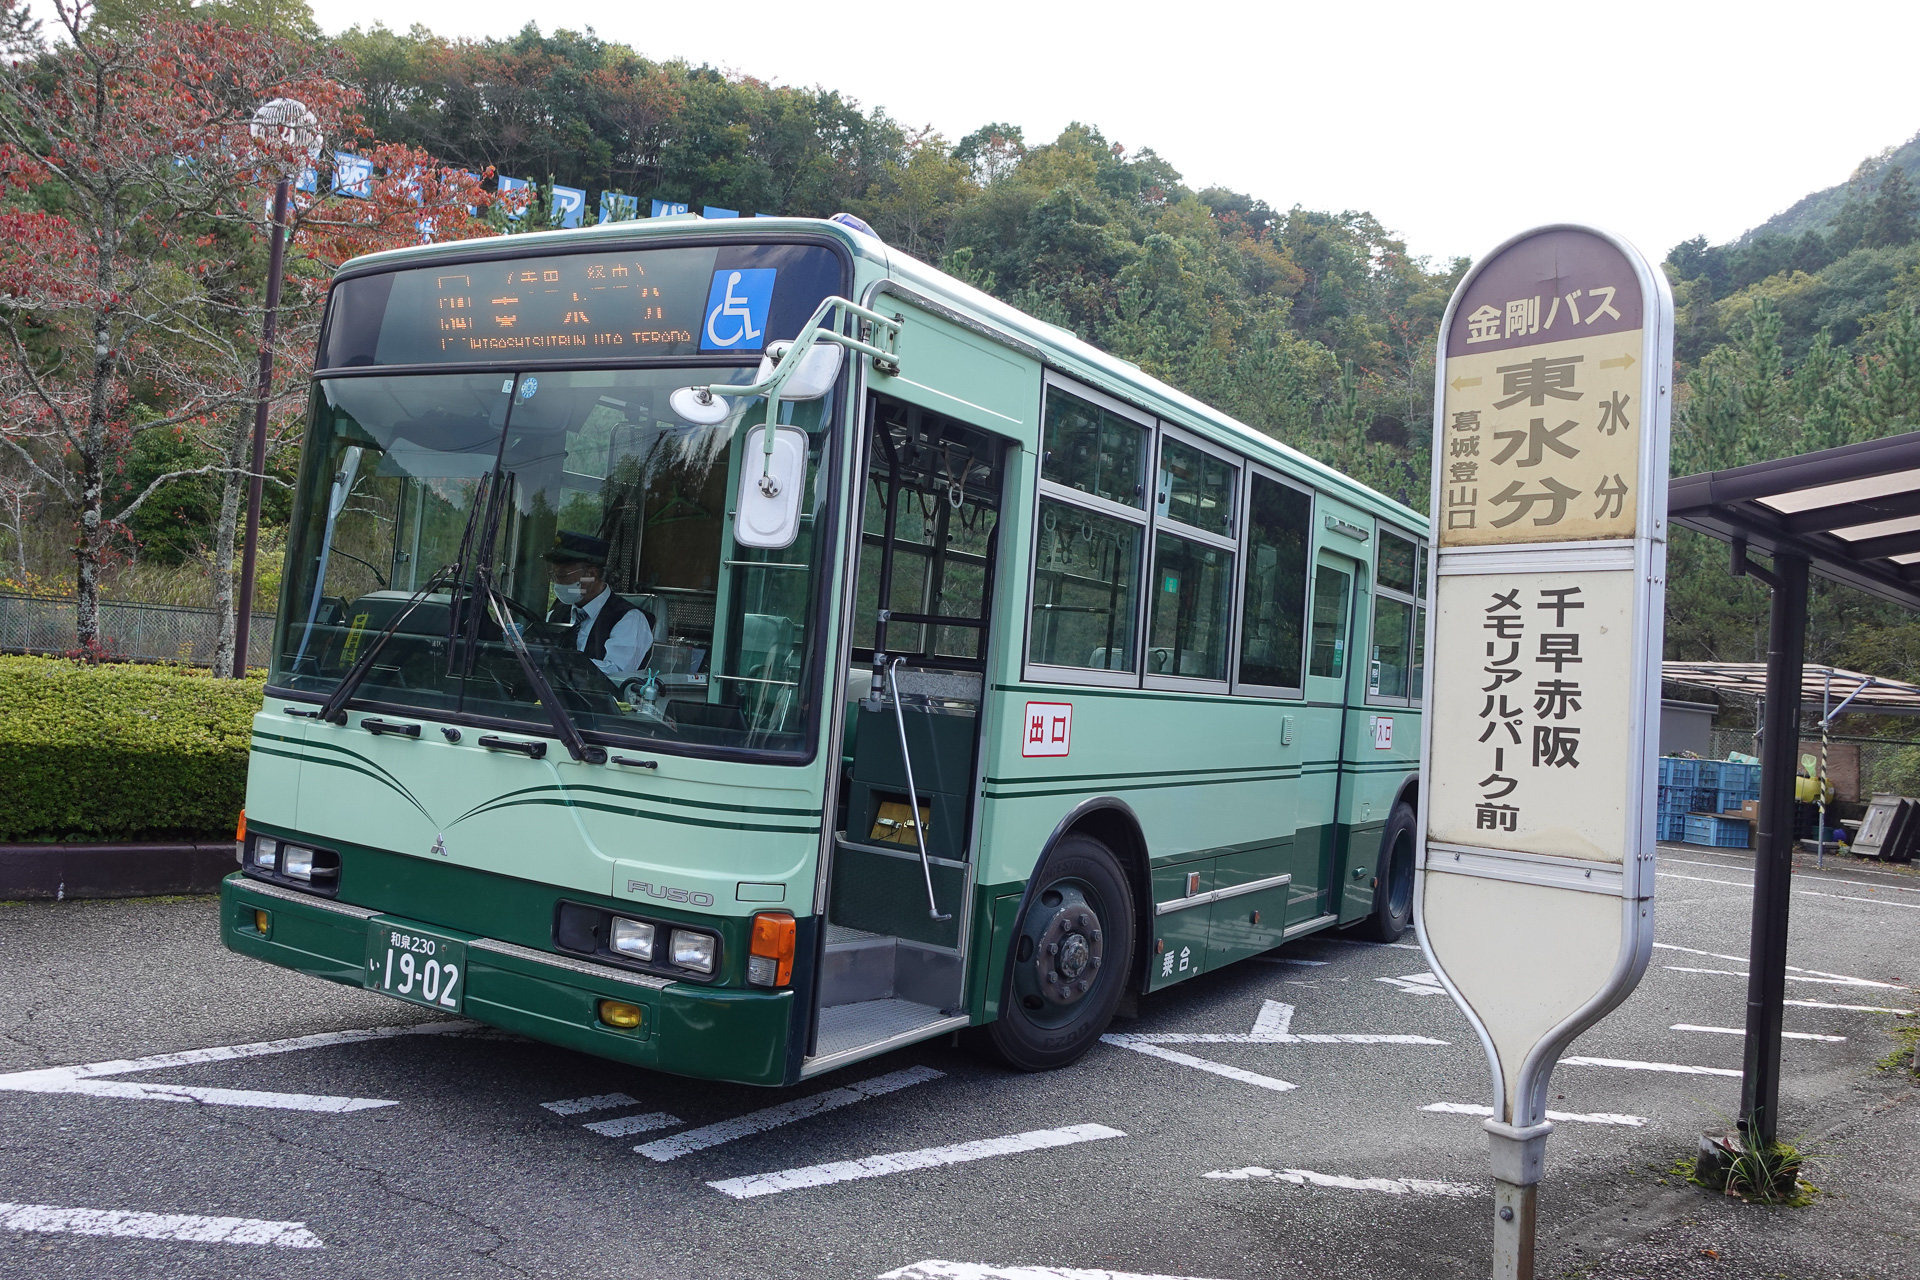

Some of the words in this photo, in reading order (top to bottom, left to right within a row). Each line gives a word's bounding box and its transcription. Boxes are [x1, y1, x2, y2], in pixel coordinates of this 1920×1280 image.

[1466, 285, 1621, 344] 金剛バス
[1448, 410, 1482, 530] 葛城登山口
[1489, 354, 1585, 529] 東水分
[1594, 390, 1630, 520] 水分
[1532, 586, 1585, 769] 千早赤阪
[1029, 714, 1066, 744] 出口
[1377, 724, 1391, 742] 入口
[1475, 588, 1524, 832] メモリアルパーク前
[627, 879, 714, 907] FUSO
[369, 958, 380, 971] い
[384, 948, 459, 1007] 19-02
[1161, 946, 1191, 978] 乗合
